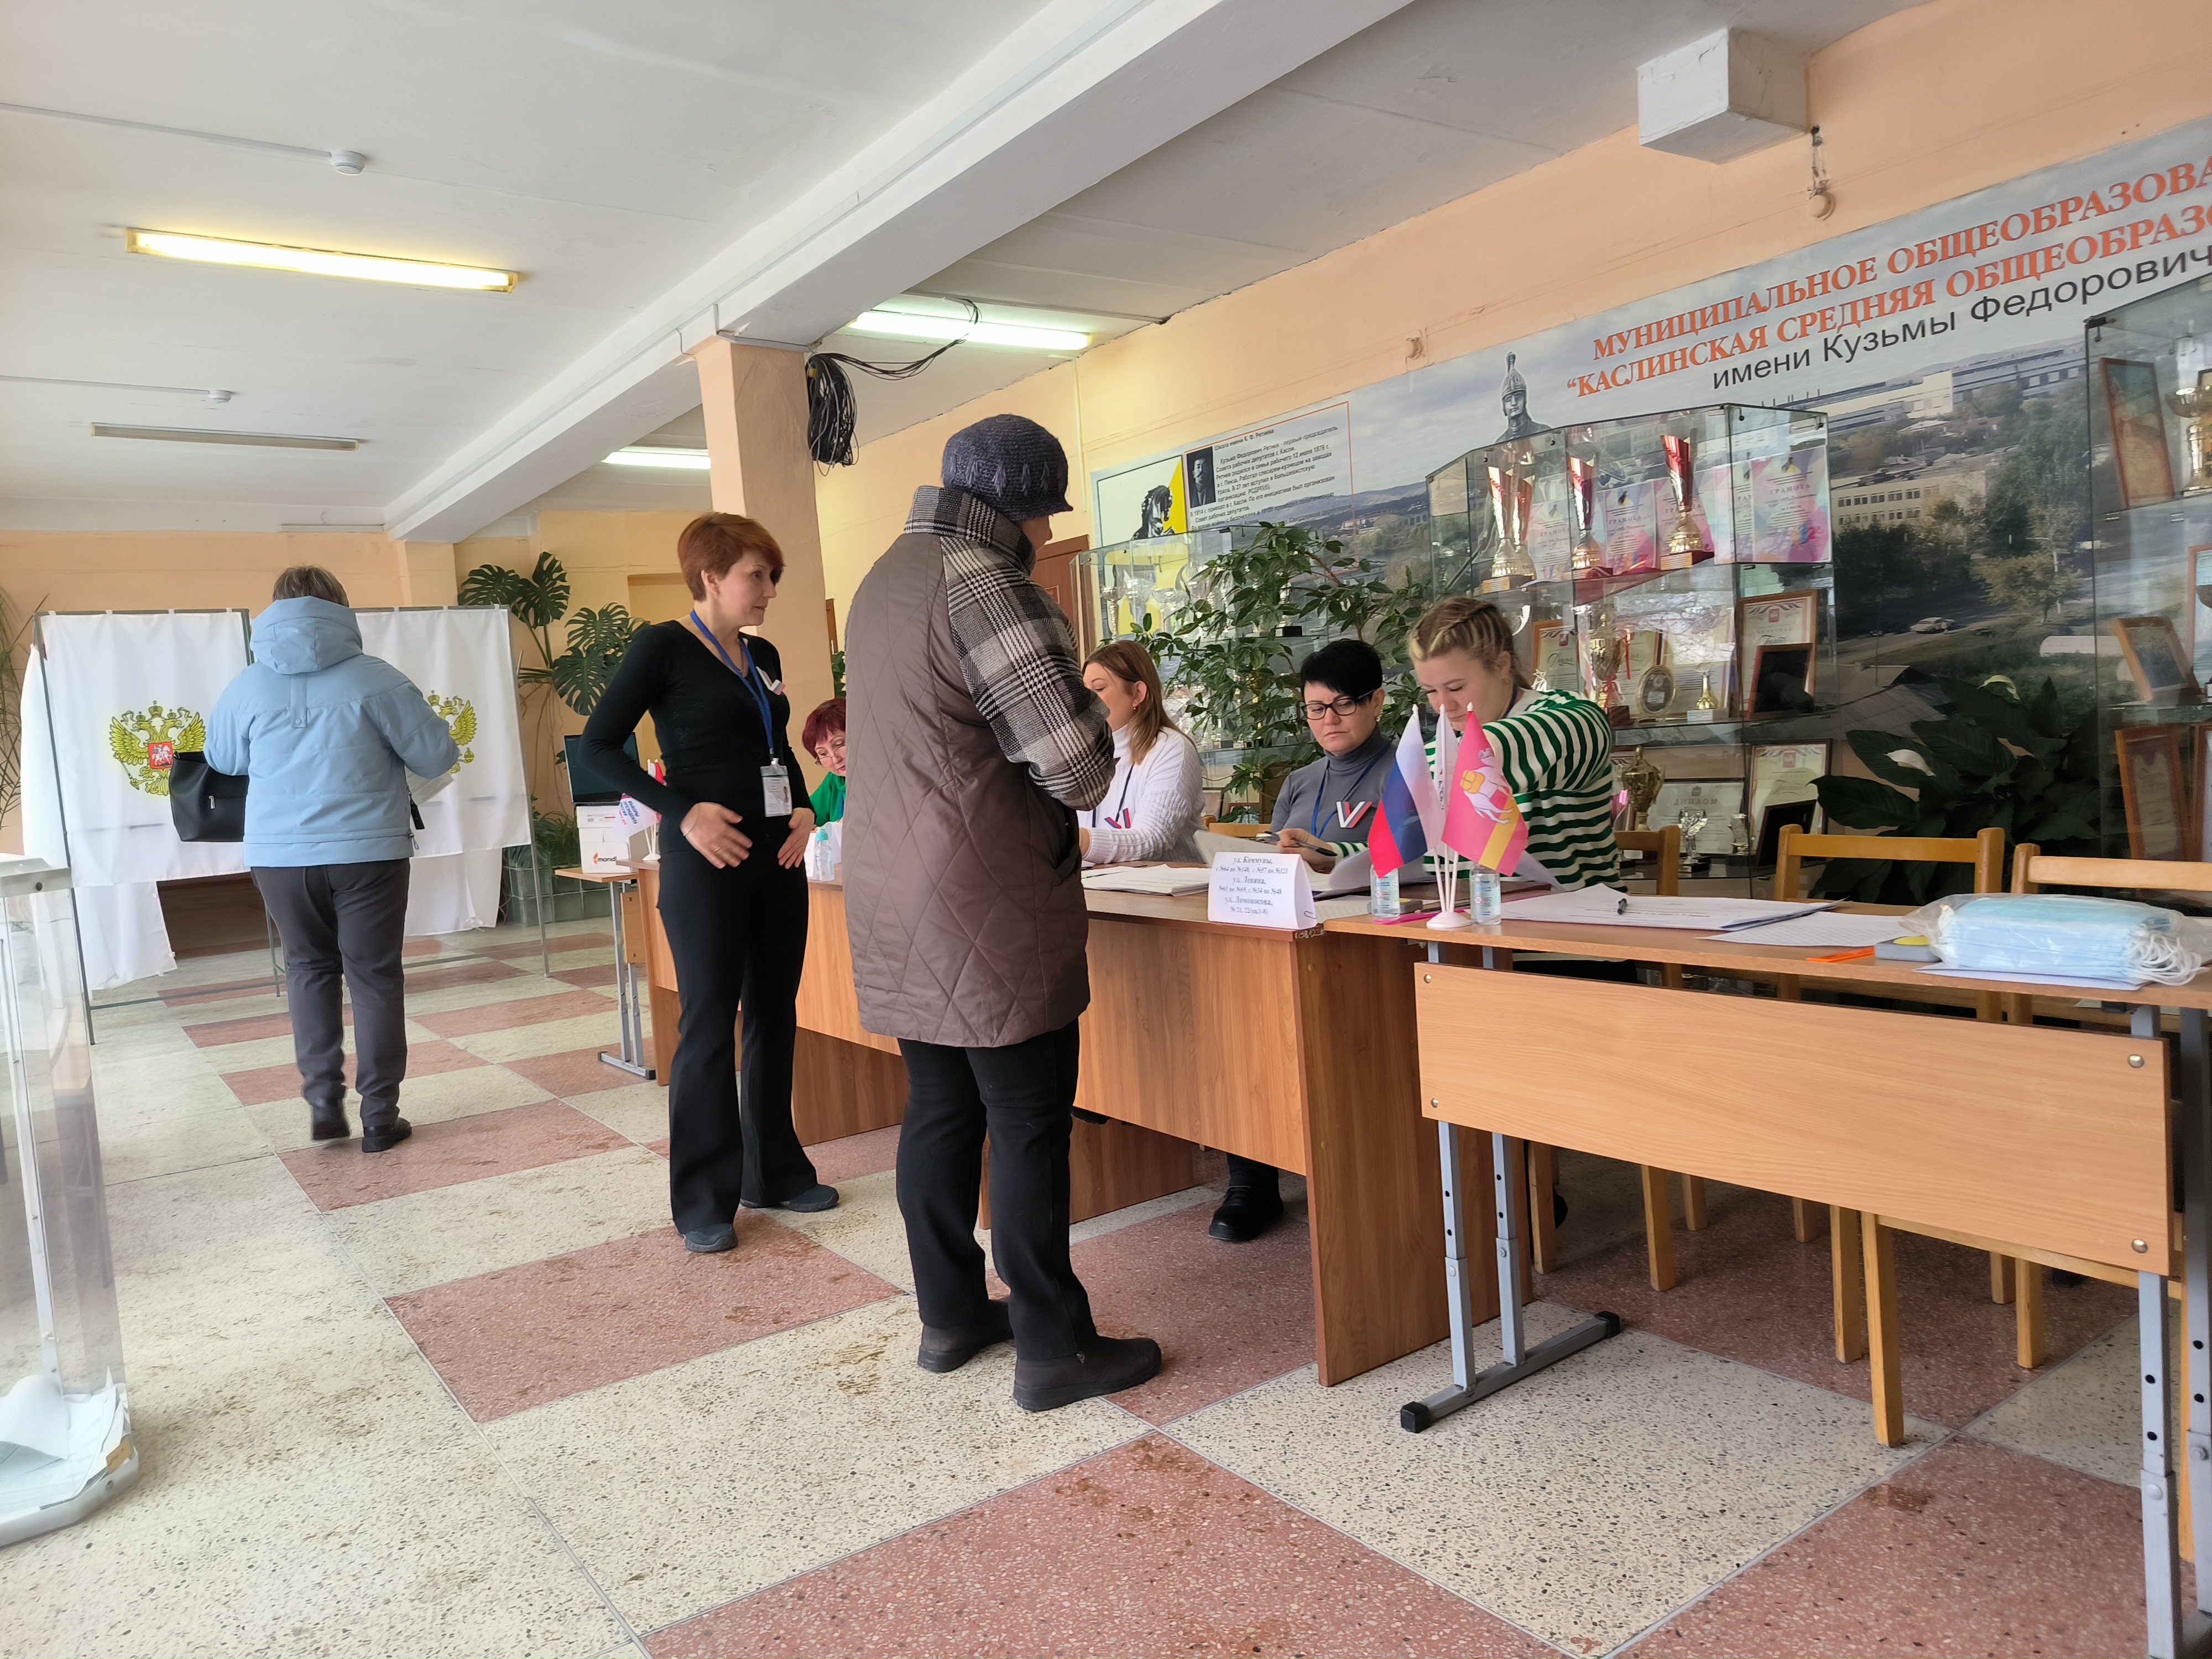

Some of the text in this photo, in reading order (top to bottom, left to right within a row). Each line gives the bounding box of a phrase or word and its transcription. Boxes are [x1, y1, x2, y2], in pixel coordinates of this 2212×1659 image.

[1593, 257, 1878, 361] МУНИЦИПАЛЬНОЕ
[1714, 245, 2212, 389] имени Кузьмы Федорович
[1777, 279, 1936, 343] СРЕДНЯЯ
[1946, 205, 2212, 297] ОБЩЕОБРАЗ
